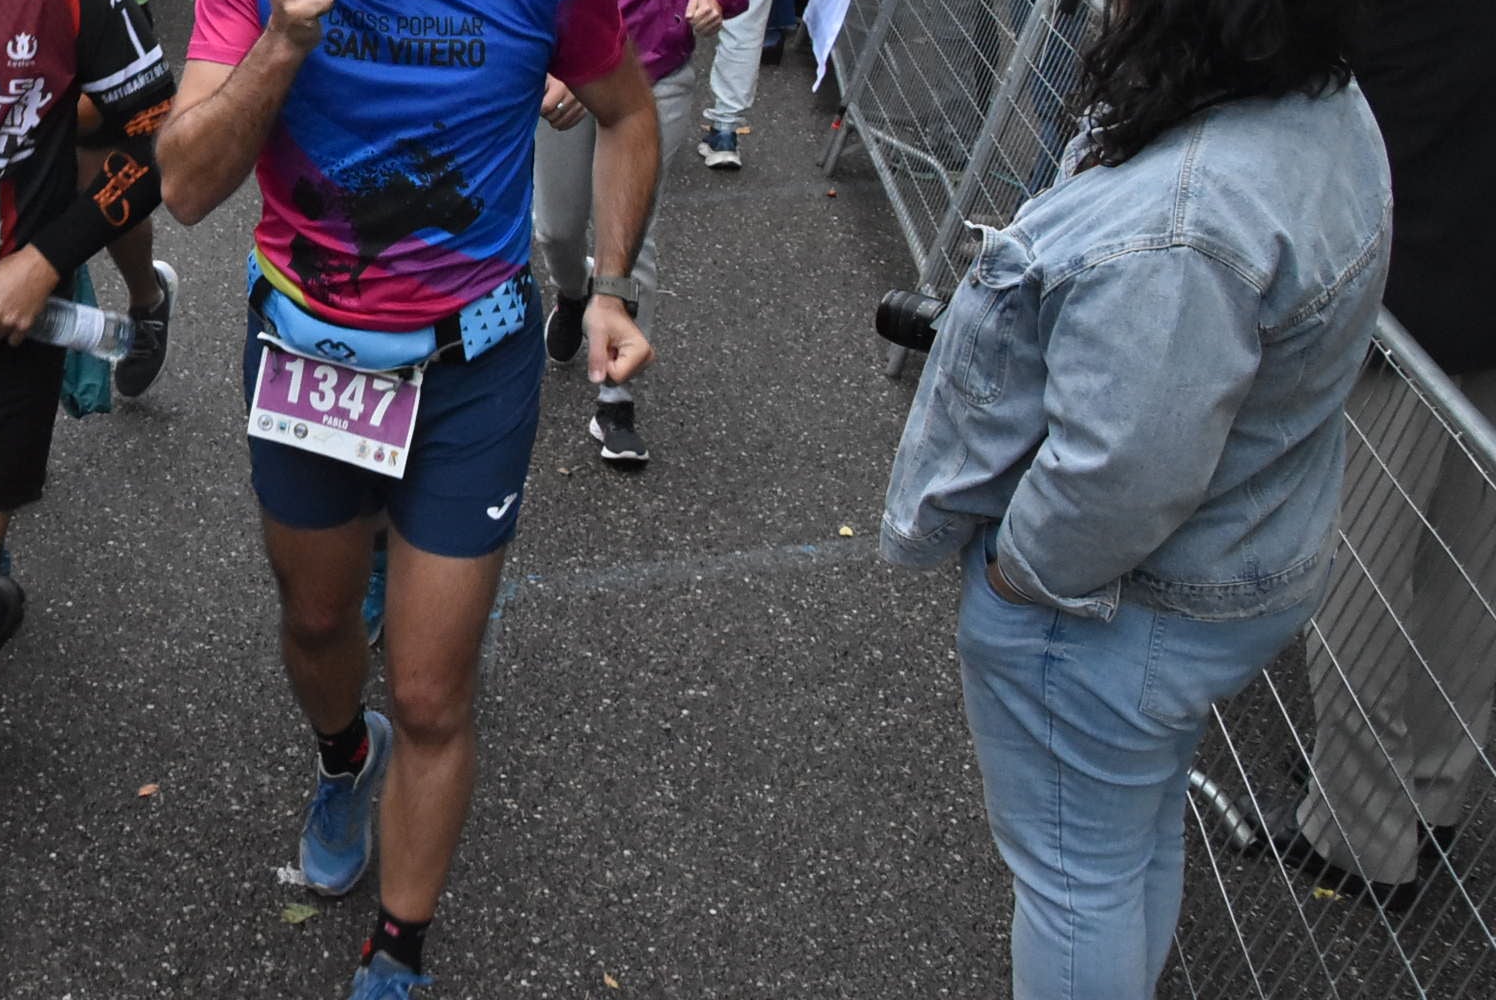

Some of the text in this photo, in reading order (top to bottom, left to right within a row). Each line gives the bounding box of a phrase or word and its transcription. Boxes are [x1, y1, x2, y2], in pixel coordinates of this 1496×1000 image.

[327, 7, 486, 37] CROSS POPULAR
[324, 28, 487, 68] SAN VITERO
[284, 357, 398, 428] 1347
